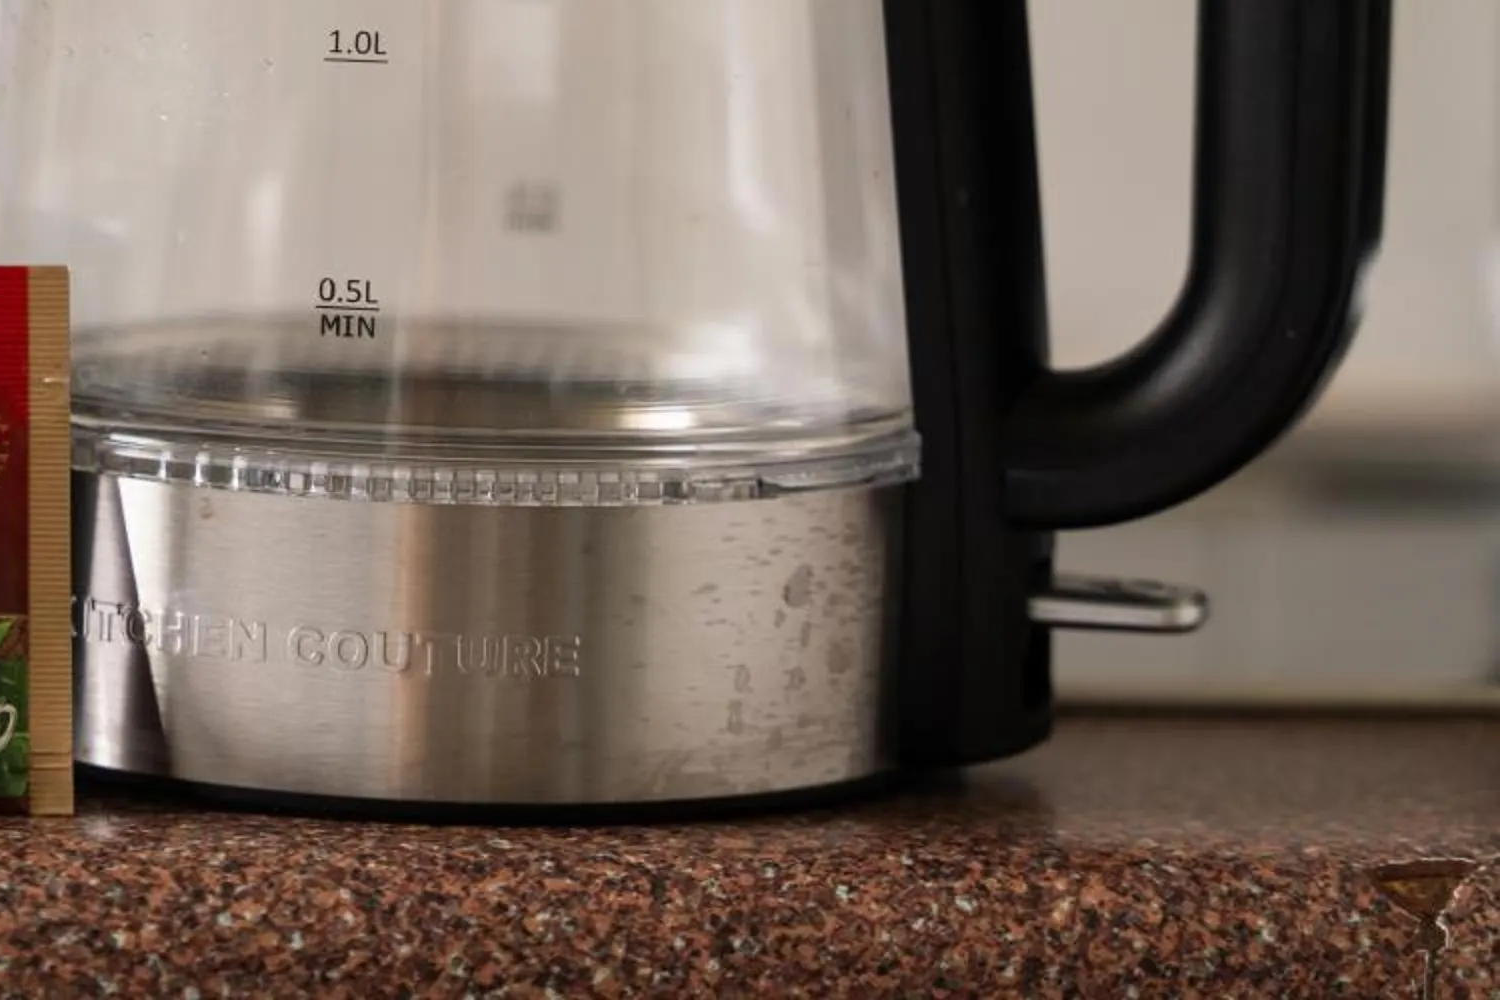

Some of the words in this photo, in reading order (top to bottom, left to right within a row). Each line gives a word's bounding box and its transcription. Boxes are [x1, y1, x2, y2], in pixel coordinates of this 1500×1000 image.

[328, 29, 387, 55] 1.0L
[319, 277, 379, 303] 0.5L
[321, 313, 375, 338] MIN
[71, 595, 267, 664] ITCHEN
[287, 625, 581, 678] COUTURE
